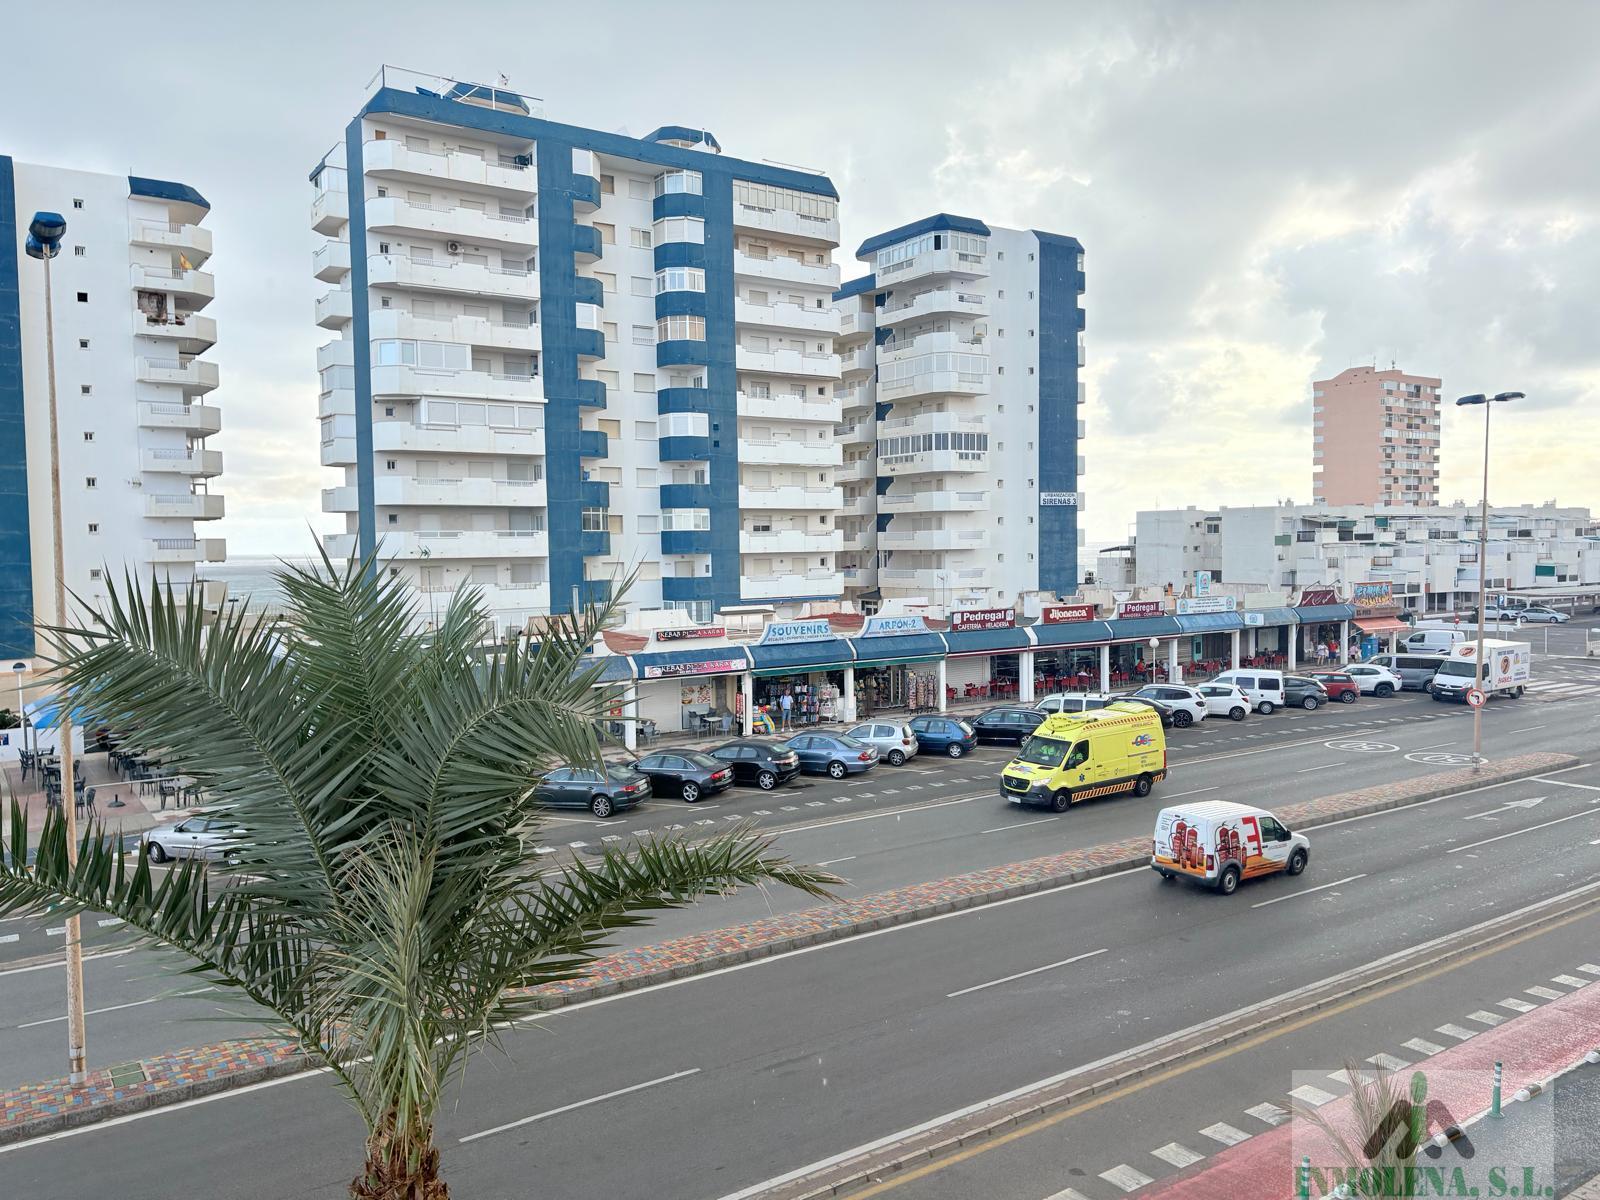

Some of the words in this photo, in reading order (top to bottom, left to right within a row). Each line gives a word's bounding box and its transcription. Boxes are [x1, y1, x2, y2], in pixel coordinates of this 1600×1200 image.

[1127, 603, 1156, 612] Pedregal
[963, 610, 1004, 621] Pedregal
[772, 624, 829, 636] SOUVENIRS
